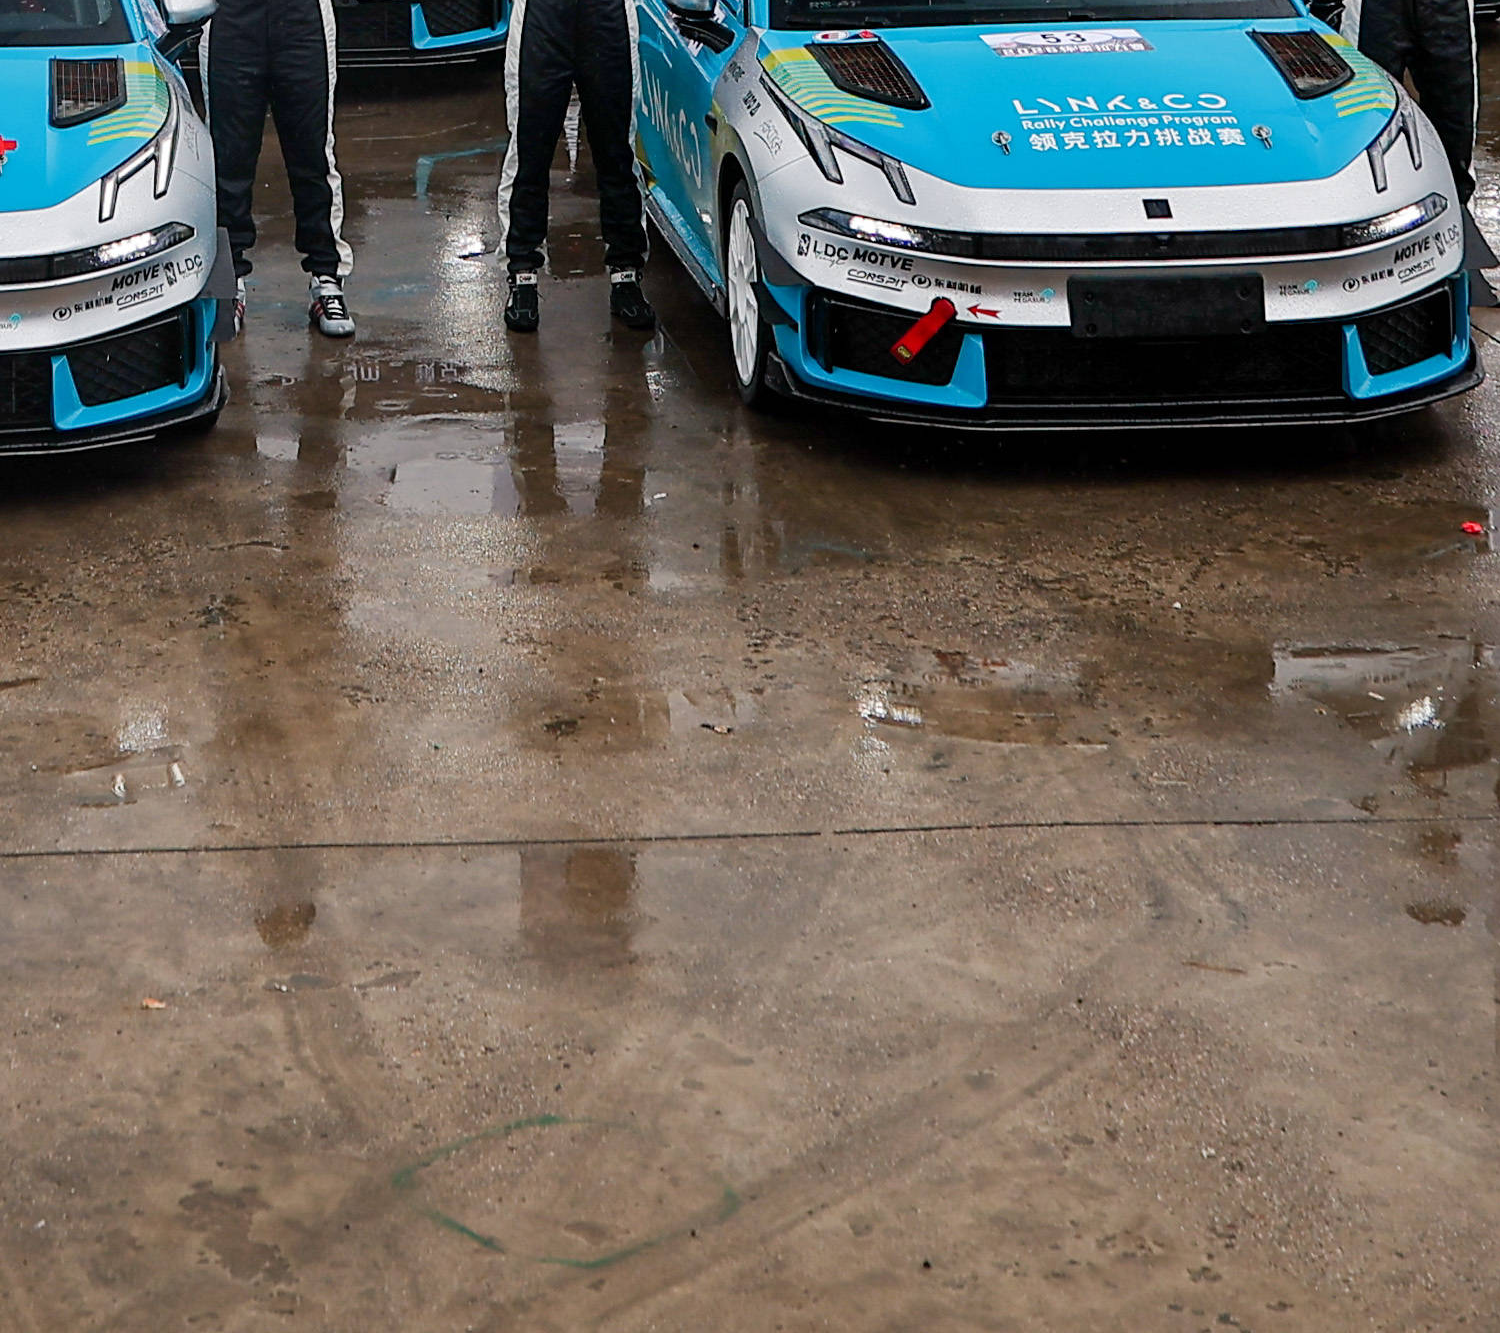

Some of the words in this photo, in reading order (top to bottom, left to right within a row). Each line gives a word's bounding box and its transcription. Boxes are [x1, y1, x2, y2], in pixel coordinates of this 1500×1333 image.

[1041, 33, 1084, 44] 53
[1012, 93, 1228, 115] LYNK&CO
[1022, 118, 1066, 131] Rally
[1070, 115, 1159, 129] Challenge
[1163, 114, 1237, 126] Program
[1029, 128, 1246, 151] 领克拉力挑战赛
[813, 241, 848, 260] LDC
[853, 248, 913, 272] MOTVE
[1393, 236, 1430, 263] MOTVE
[178, 255, 203, 276] LDC
[110, 265, 160, 291] MOTVE
